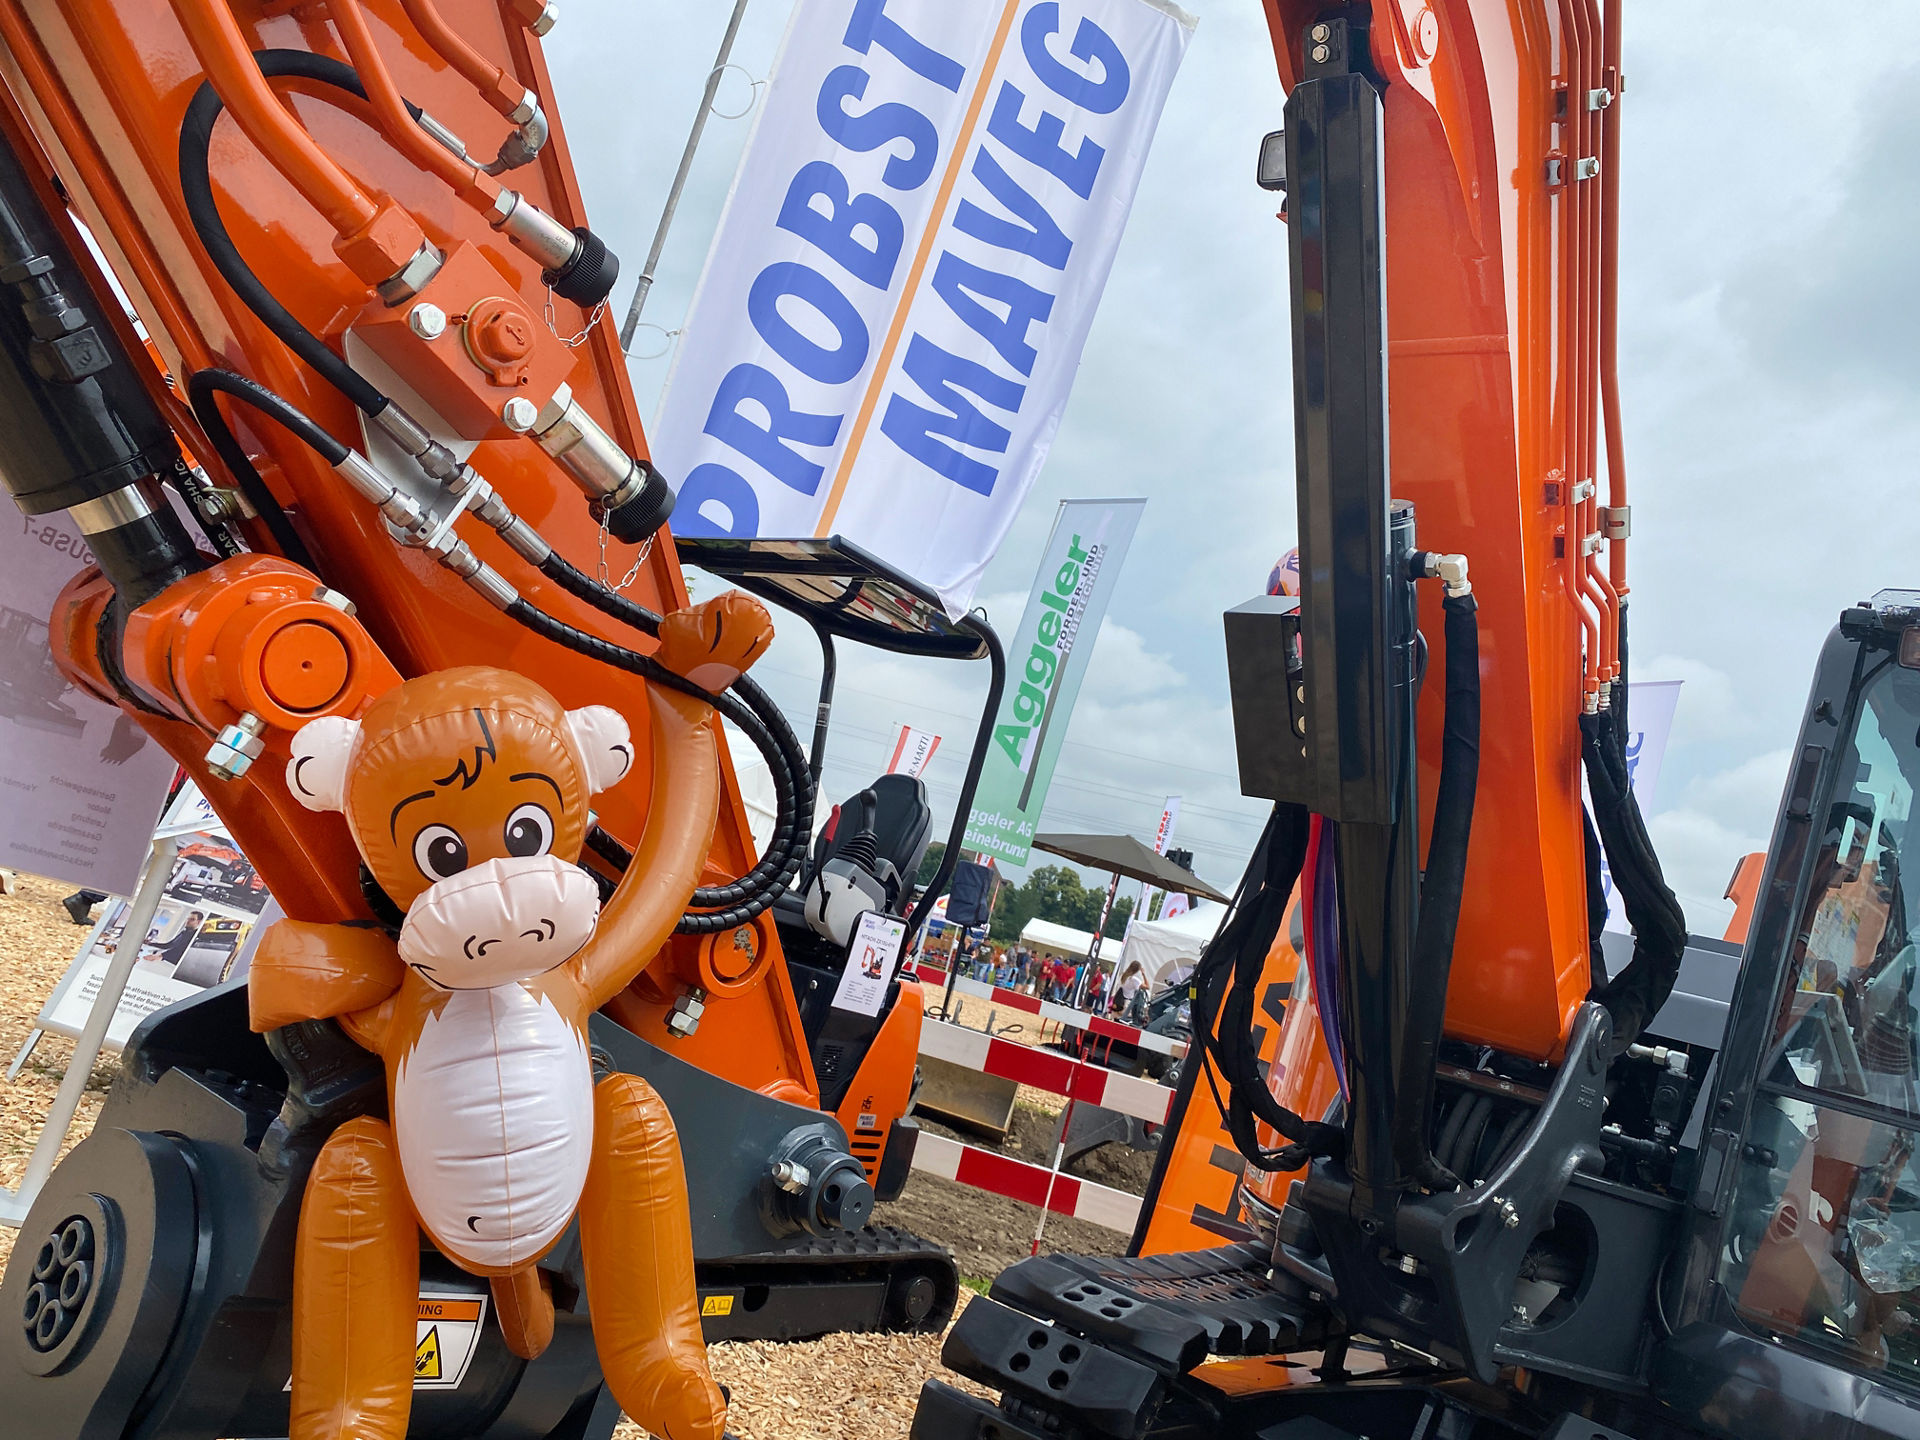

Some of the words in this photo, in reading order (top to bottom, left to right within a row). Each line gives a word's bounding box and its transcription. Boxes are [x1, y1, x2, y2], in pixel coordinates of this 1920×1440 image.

[671, 0, 966, 538] PROBST
[880, 2, 1130, 497] MAVEG
[1064, 544, 1108, 654] HEBETECHNIK
[1082, 544, 1098, 577] UND
[994, 534, 1089, 769] Aggeler
[968, 808, 1015, 832] ggeler
